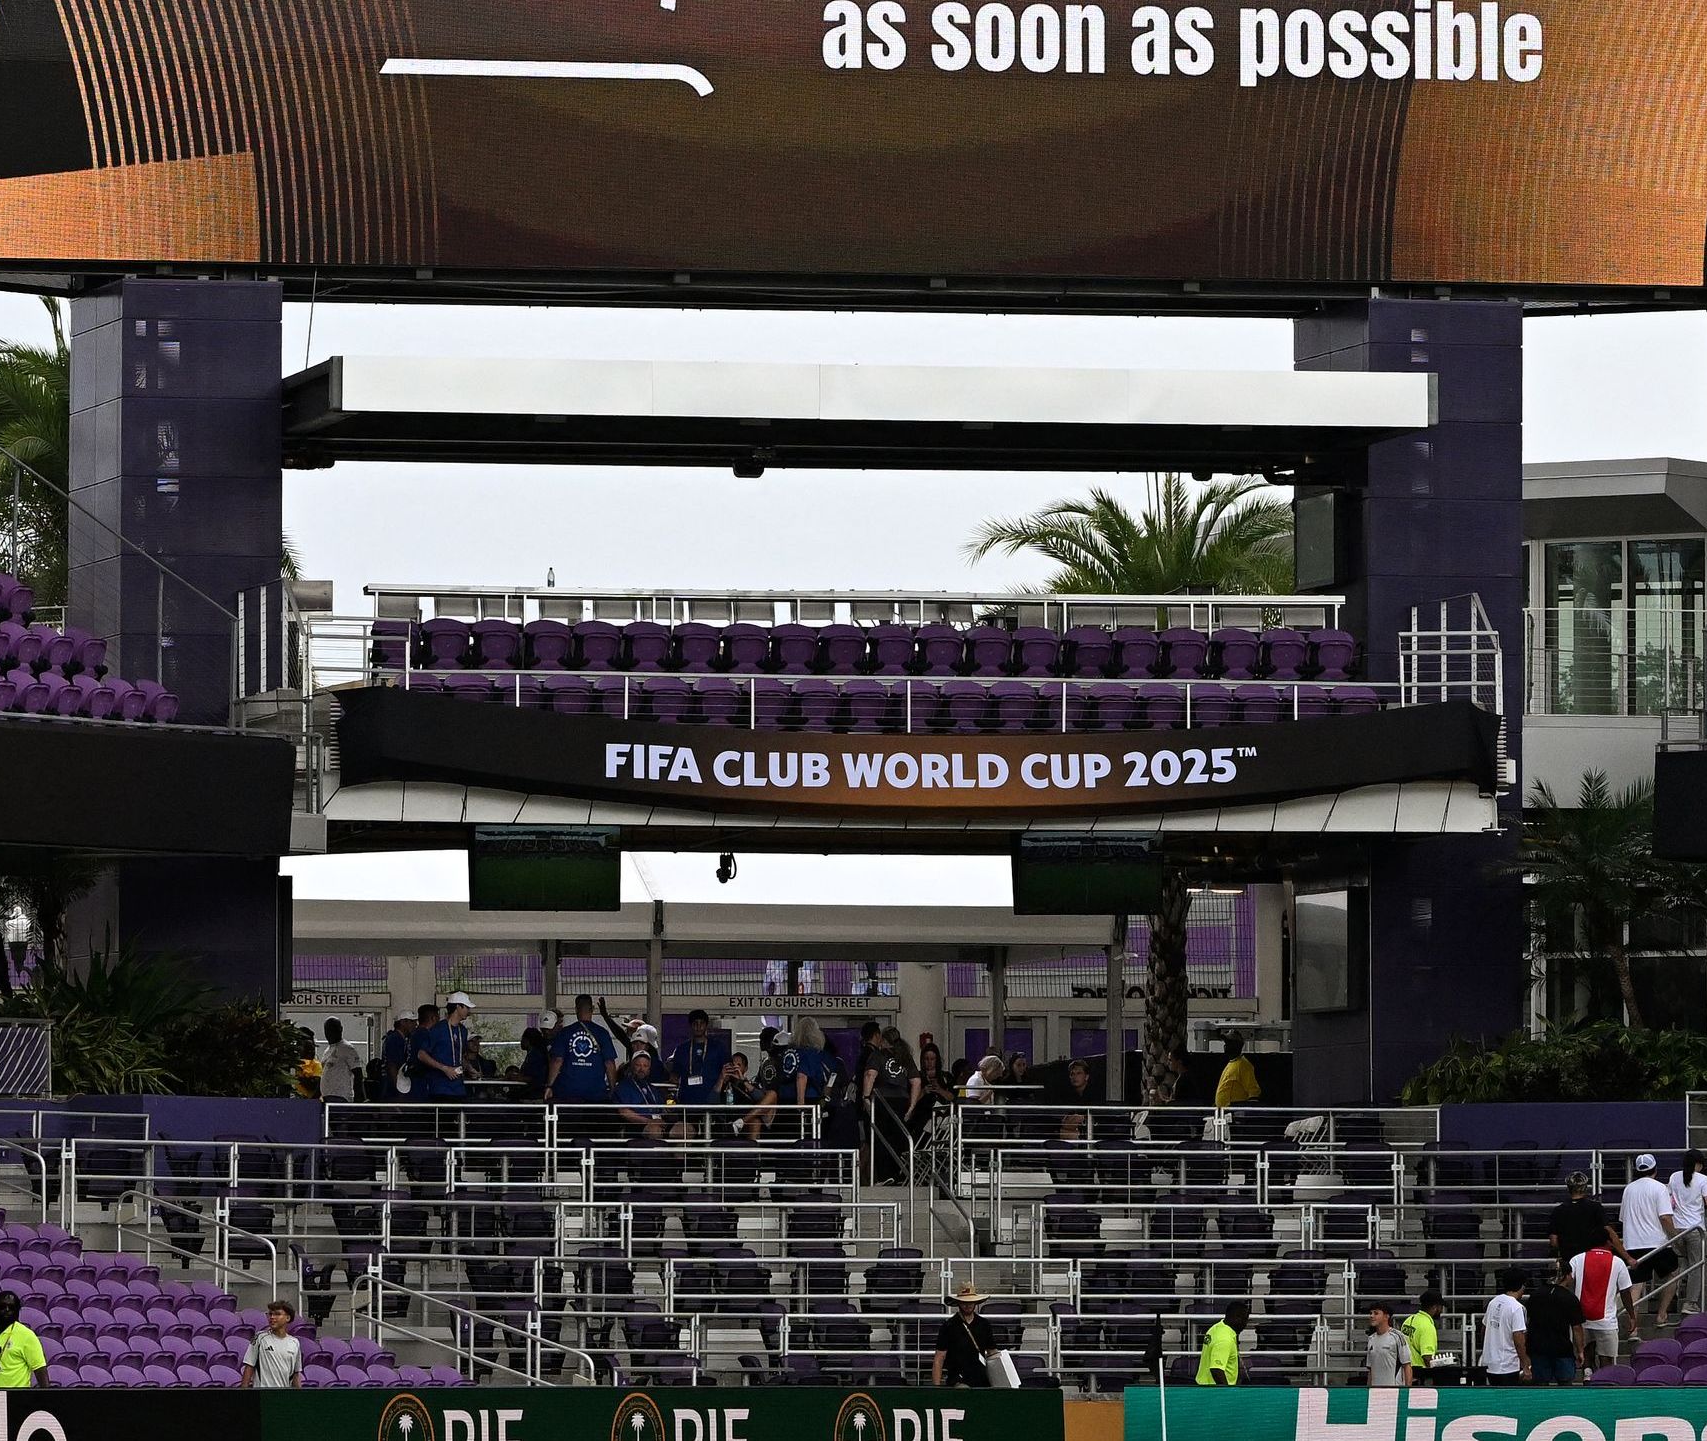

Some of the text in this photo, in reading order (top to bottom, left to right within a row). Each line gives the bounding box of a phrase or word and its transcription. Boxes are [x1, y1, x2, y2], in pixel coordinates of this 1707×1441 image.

[930, 1, 1105, 73] soon
[1129, 4, 1214, 76] as
[604, 742, 703, 785] FIFA
[713, 750, 832, 788] CLUB
[842, 752, 1009, 790] WORLD
[1020, 752, 1111, 789] CUP
[315, 994, 361, 1005] STREET
[729, 997, 871, 1008] EXIT TO CHURCH STREET
